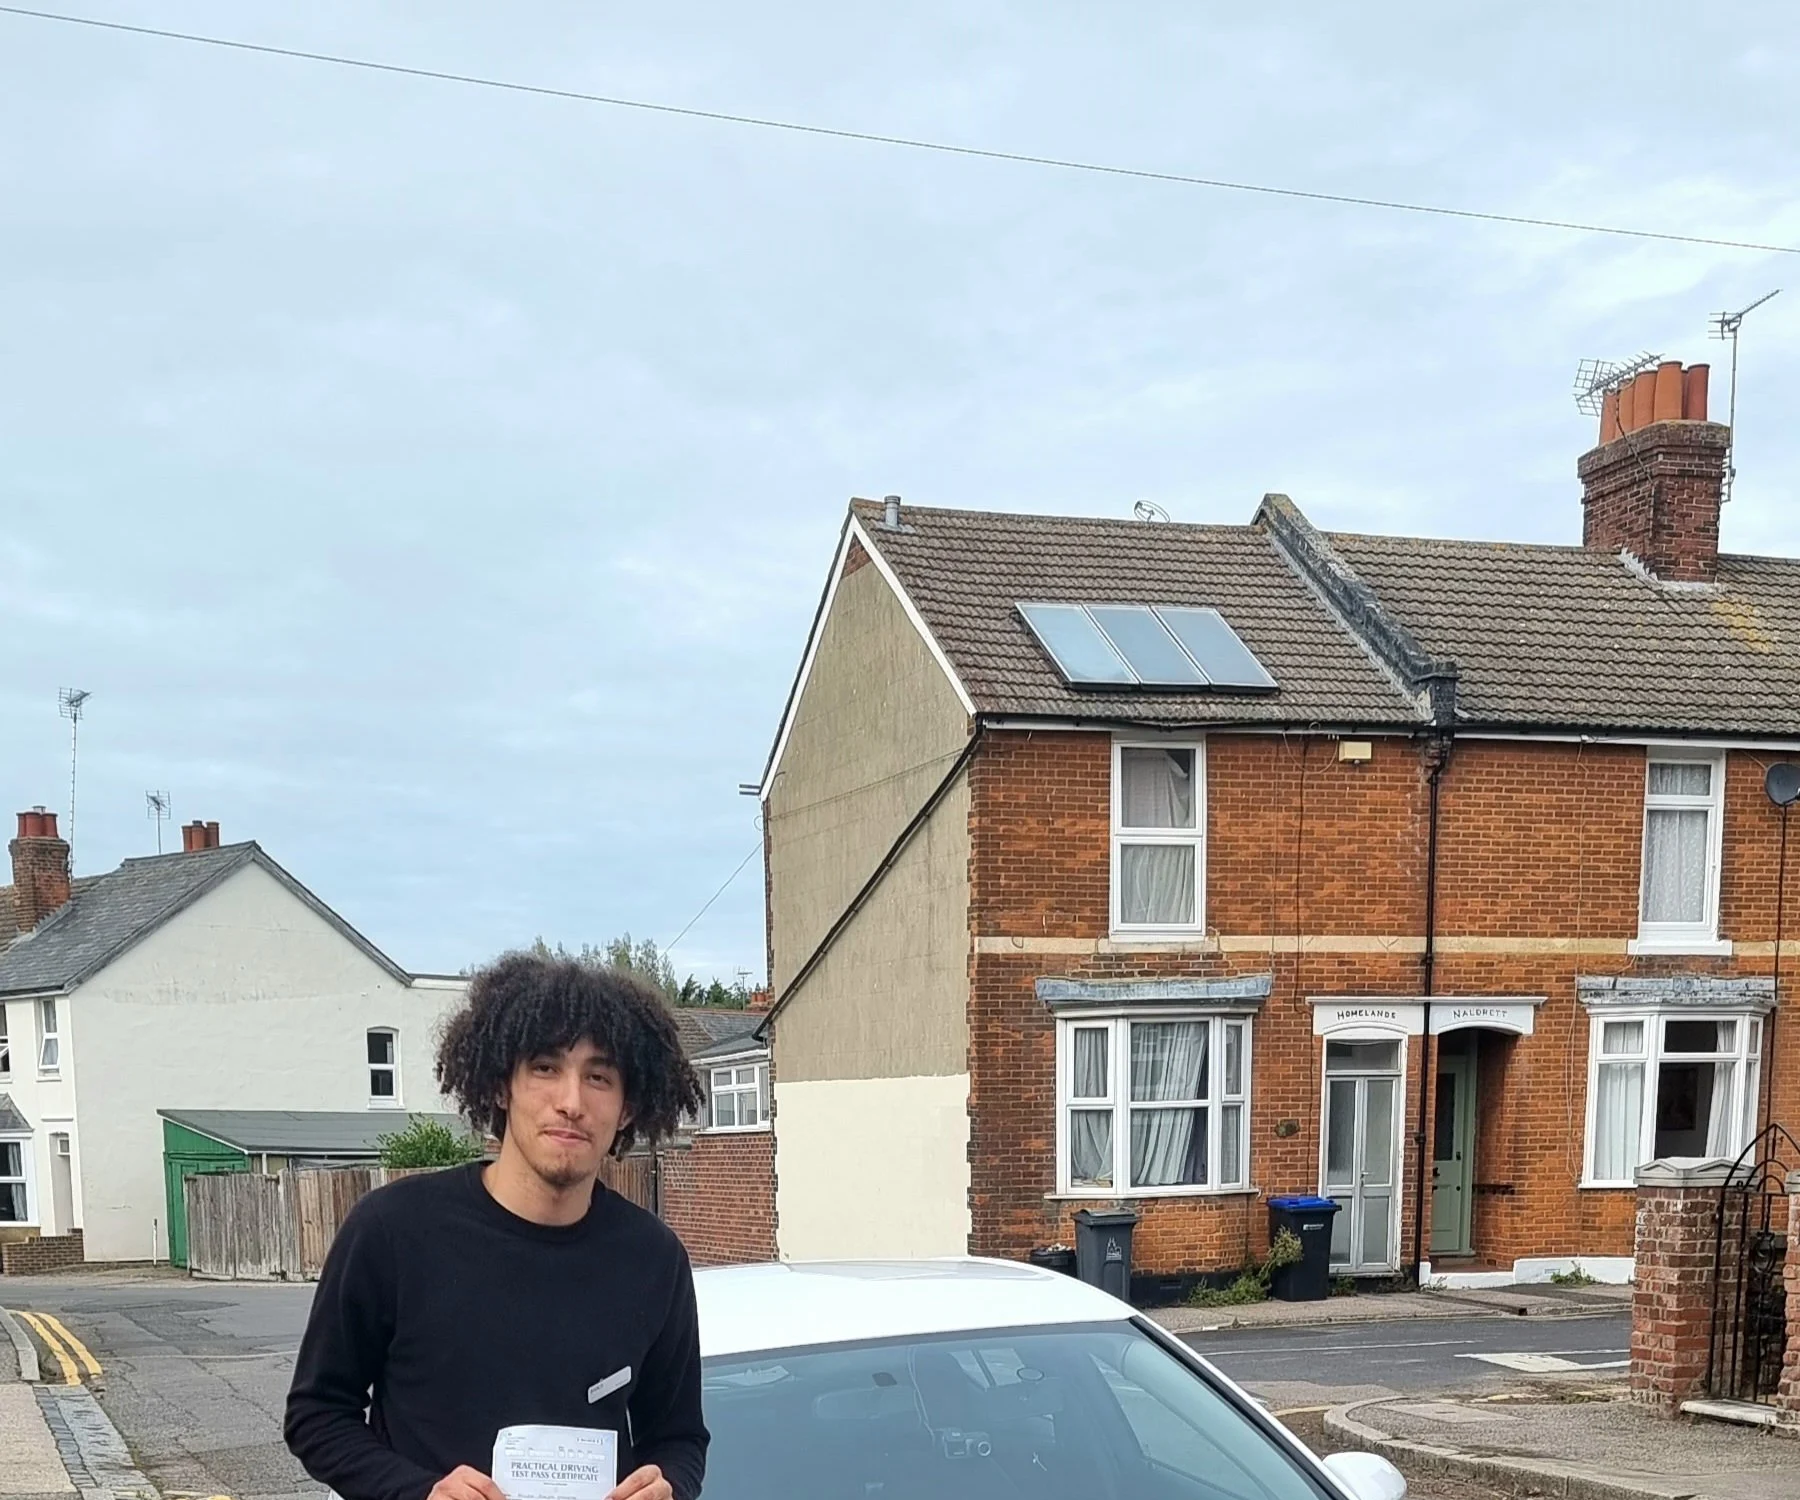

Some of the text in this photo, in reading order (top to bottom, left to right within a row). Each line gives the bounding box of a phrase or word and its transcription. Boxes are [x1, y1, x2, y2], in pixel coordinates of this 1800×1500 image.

[1336, 1009, 1397, 1020] HOMELANDS
[511, 1462, 599, 1473] PRACTICAL DRIVING
[511, 1470, 598, 1481] TEST PASS CERTIFICATE
